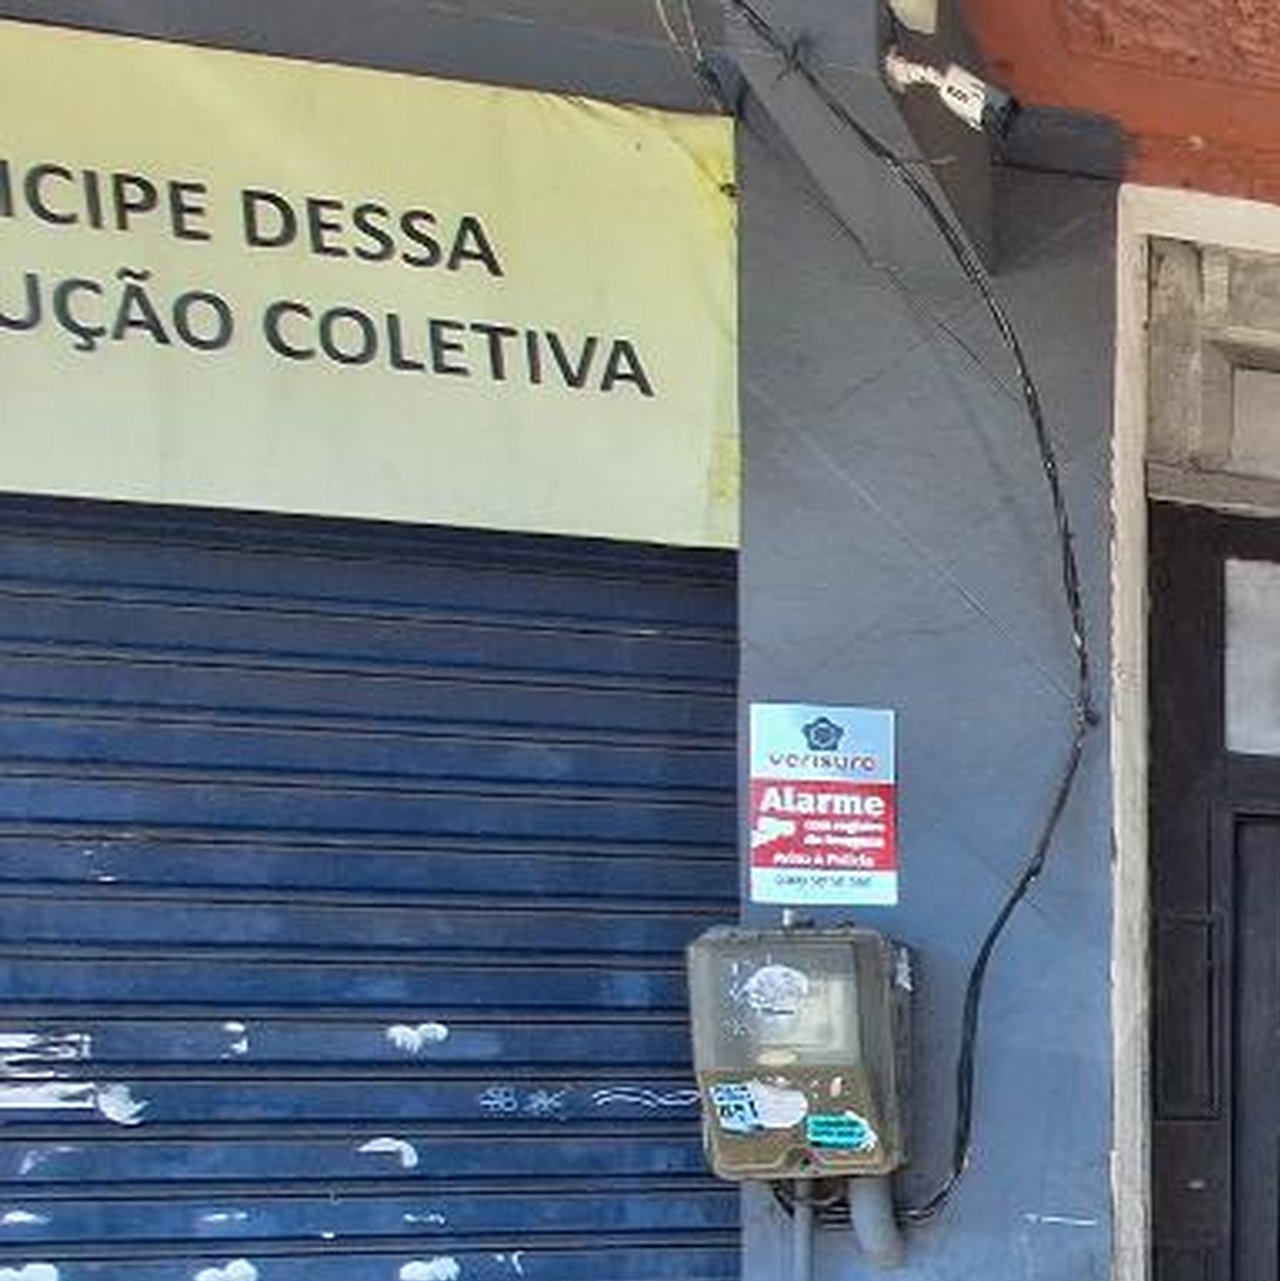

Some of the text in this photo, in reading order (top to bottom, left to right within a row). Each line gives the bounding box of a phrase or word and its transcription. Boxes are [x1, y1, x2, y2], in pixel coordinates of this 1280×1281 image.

[241, 188, 504, 277] DESSA
[263, 300, 655, 398] COLETIVA
[759, 786, 886, 817] Alarme
